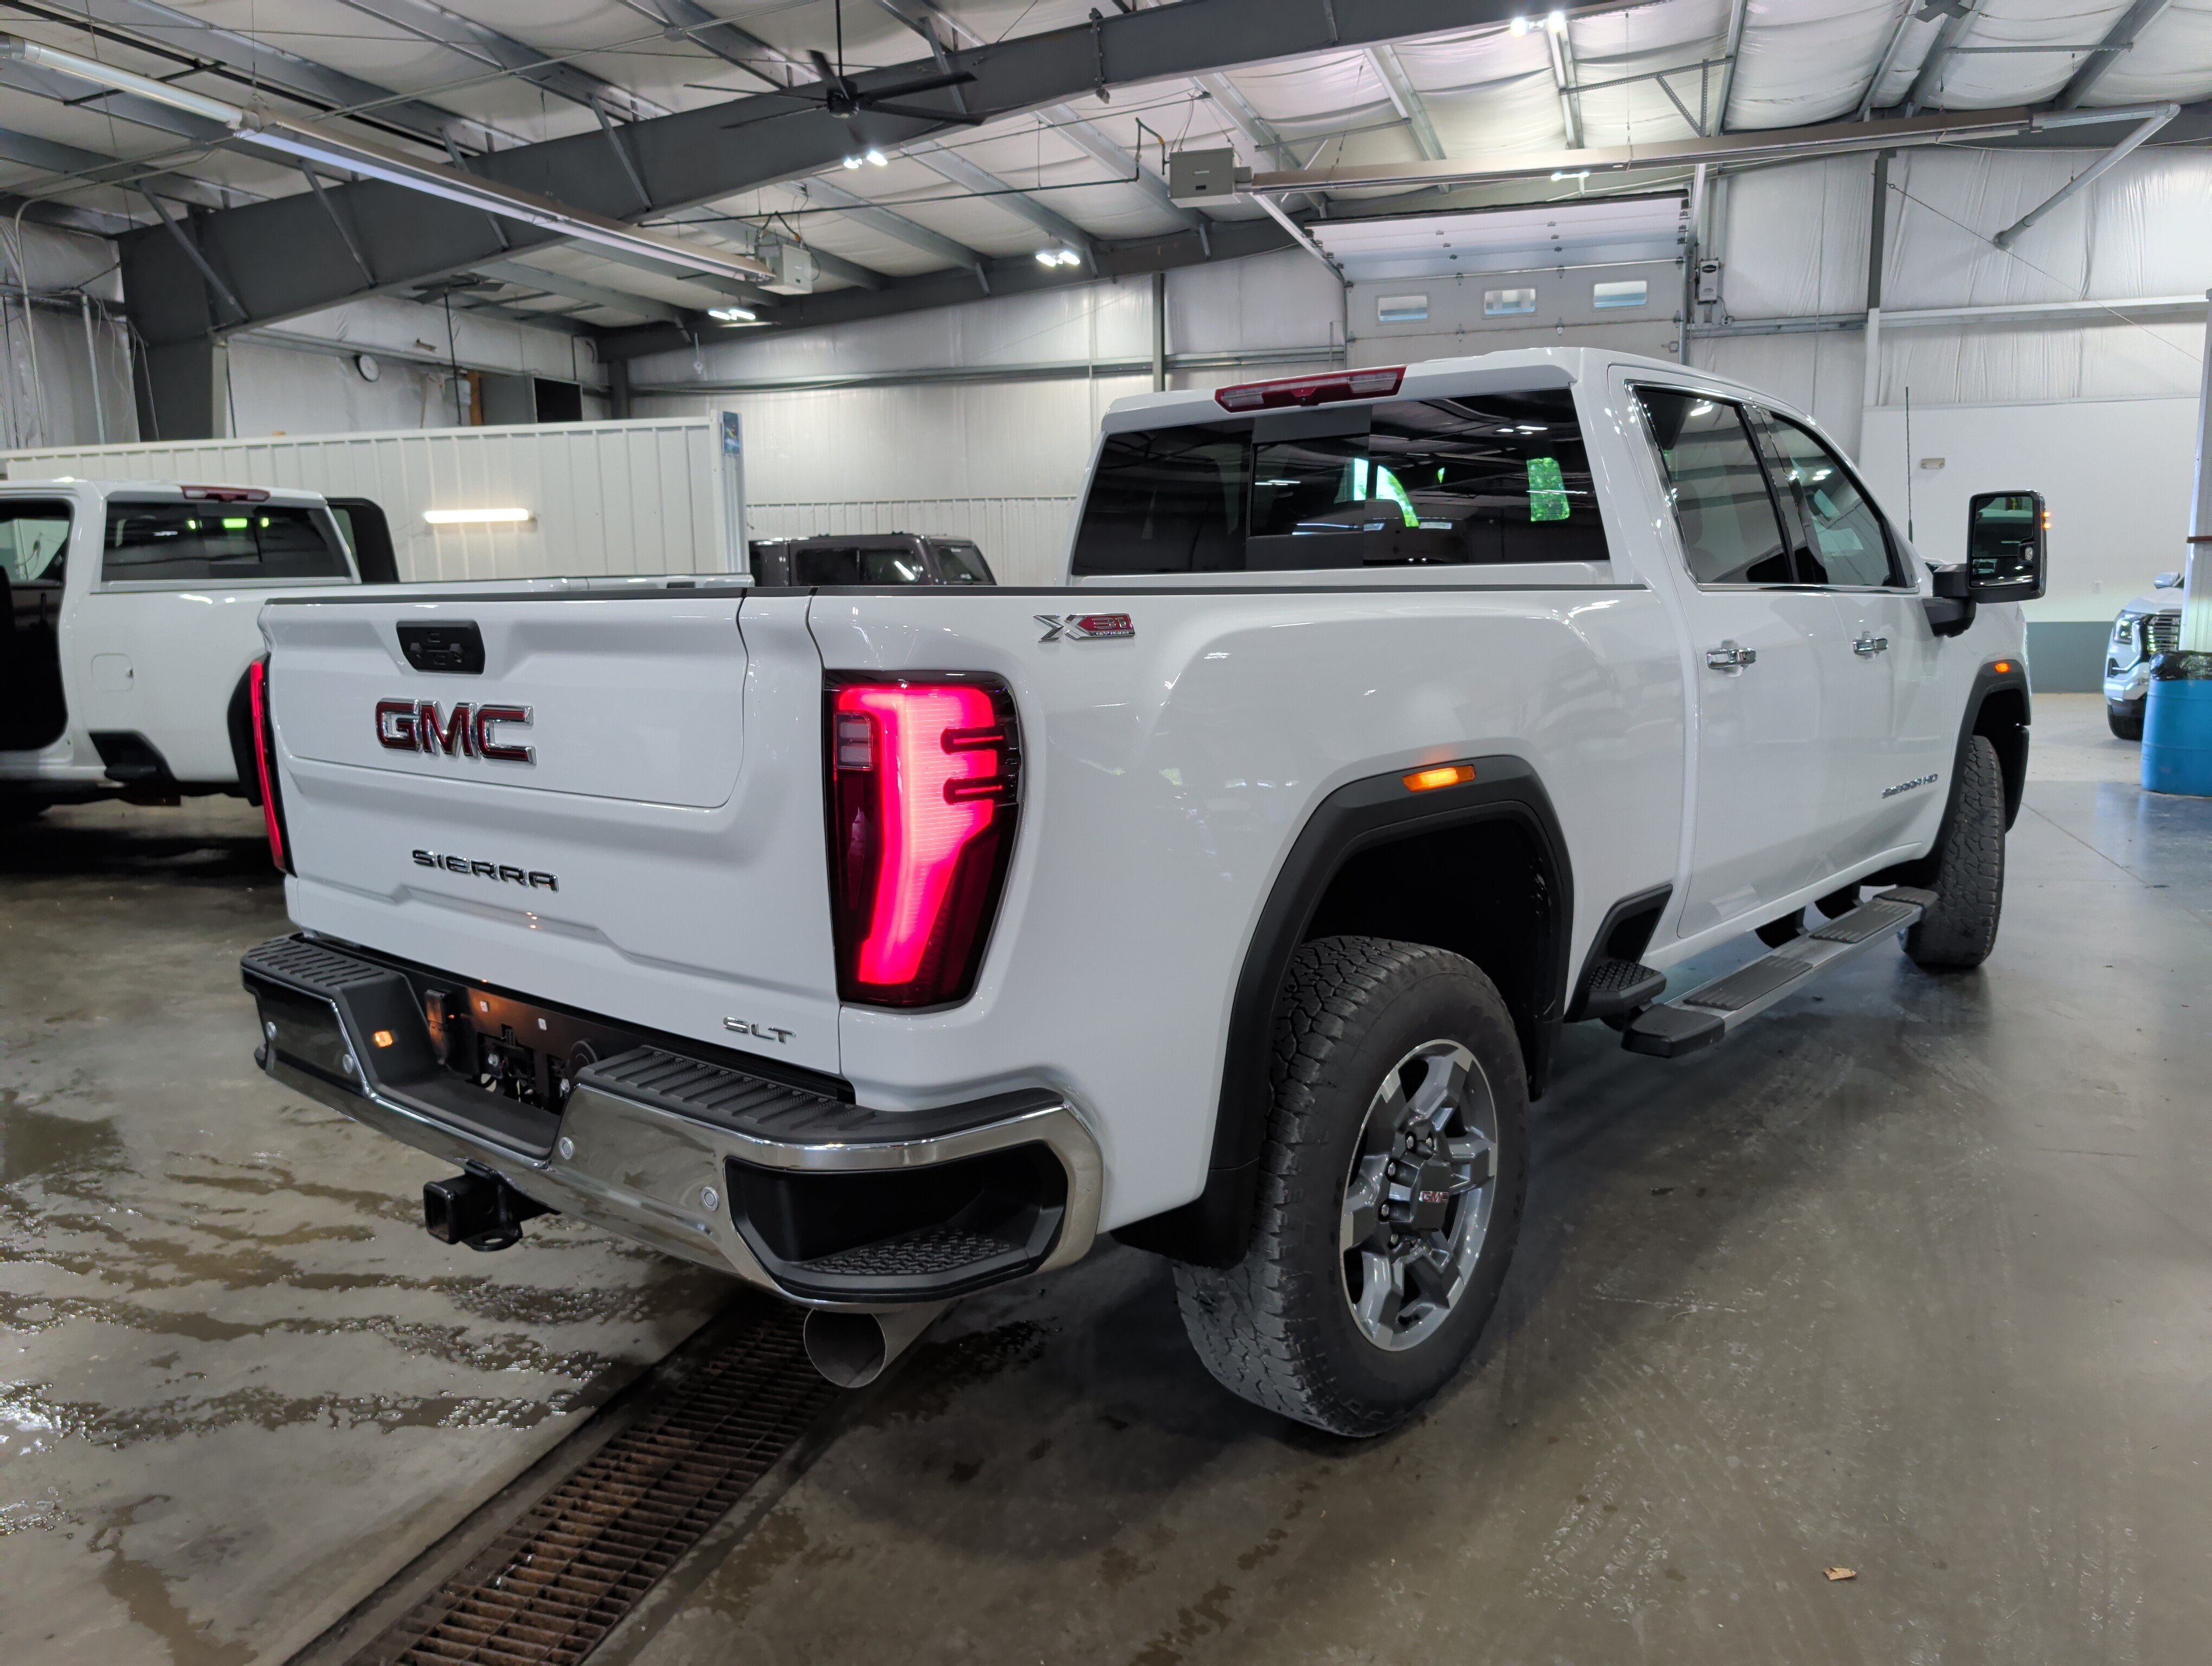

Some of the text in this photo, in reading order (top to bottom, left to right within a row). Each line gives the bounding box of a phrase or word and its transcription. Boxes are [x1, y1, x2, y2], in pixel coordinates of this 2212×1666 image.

[375, 697, 537, 765] GMC
[412, 849, 560, 892] SIERRA
[723, 1016, 797, 1045] SLT
[1419, 1190, 1449, 1203] GMC
